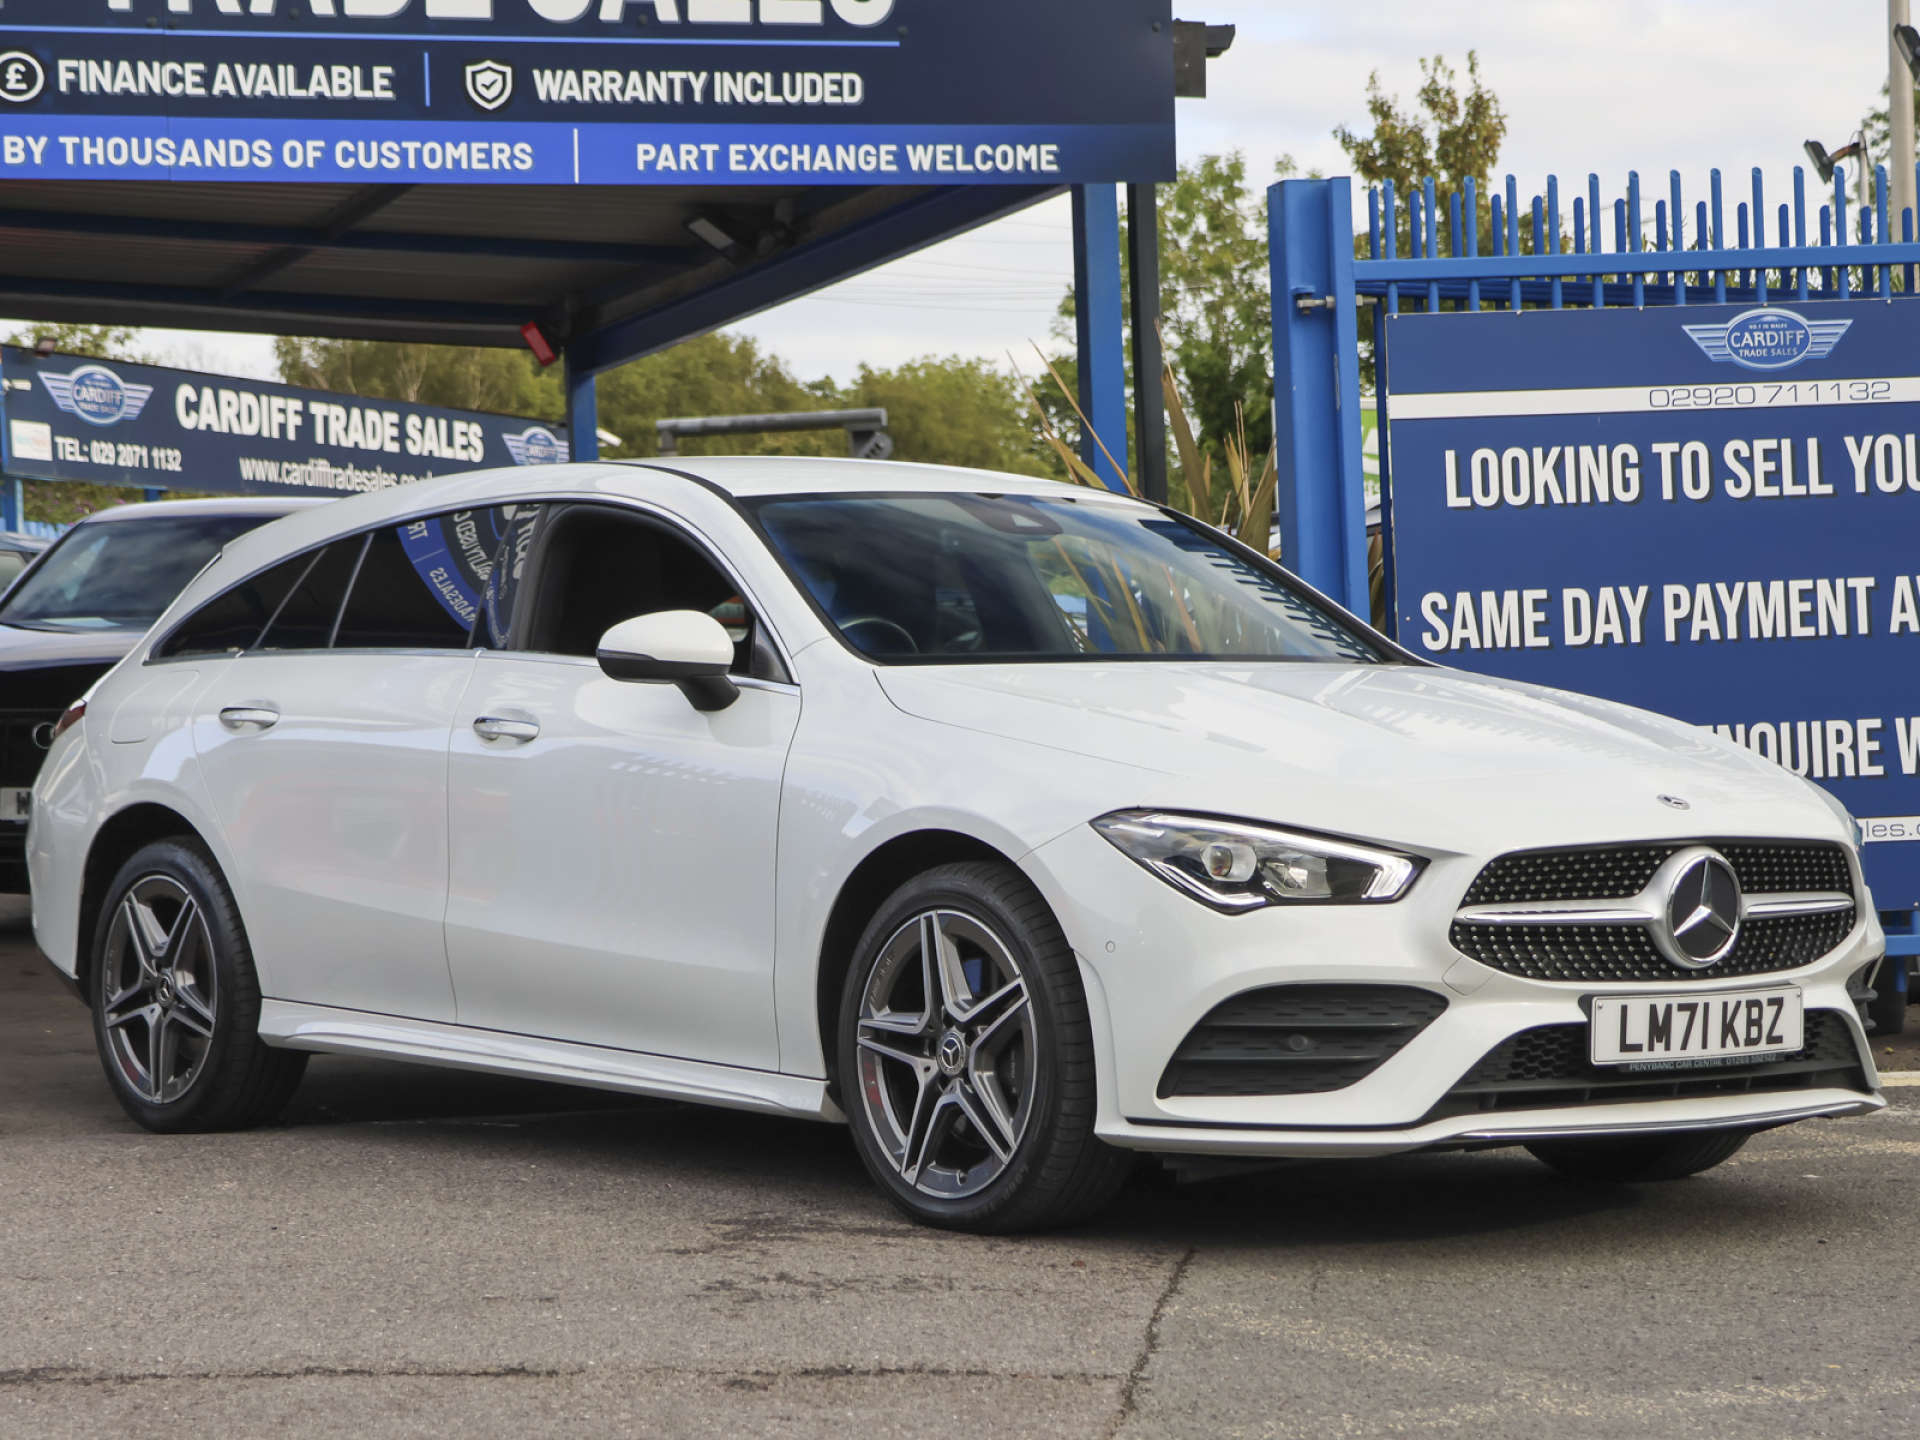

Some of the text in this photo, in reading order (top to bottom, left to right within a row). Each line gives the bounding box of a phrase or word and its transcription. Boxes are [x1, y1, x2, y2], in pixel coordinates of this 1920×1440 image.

[57, 59, 395, 99] FINANCE AVAILABLE
[533, 69, 864, 104] WARRANTY INCLUDED
[3, 135, 534, 171] BY THOUSANDS OF CUSTOMERS
[636, 143, 1060, 172] PART EXCHANGE WELCOME
[1730, 330, 1805, 347] CARDIFF
[1739, 347, 1799, 358] TRADE SALES
[73, 385, 123, 403] CARDIFF
[1649, 381, 1891, 408] 02920 711132
[175, 383, 485, 463] CARDIFF TRADE SALES
[54, 436, 90, 463] TEL:
[90, 440, 116, 466] 029
[117, 443, 149, 469] 2071
[151, 447, 183, 472] 1132
[1445, 444, 1640, 508] LOOKING
[1652, 441, 1711, 500] TO
[1724, 437, 1834, 498] SELL
[1843, 433, 1920, 493] YOU
[1421, 575, 1920, 651] SAME DAY PAYMENT A
[1619, 997, 1784, 1053] LM71 KBZ
